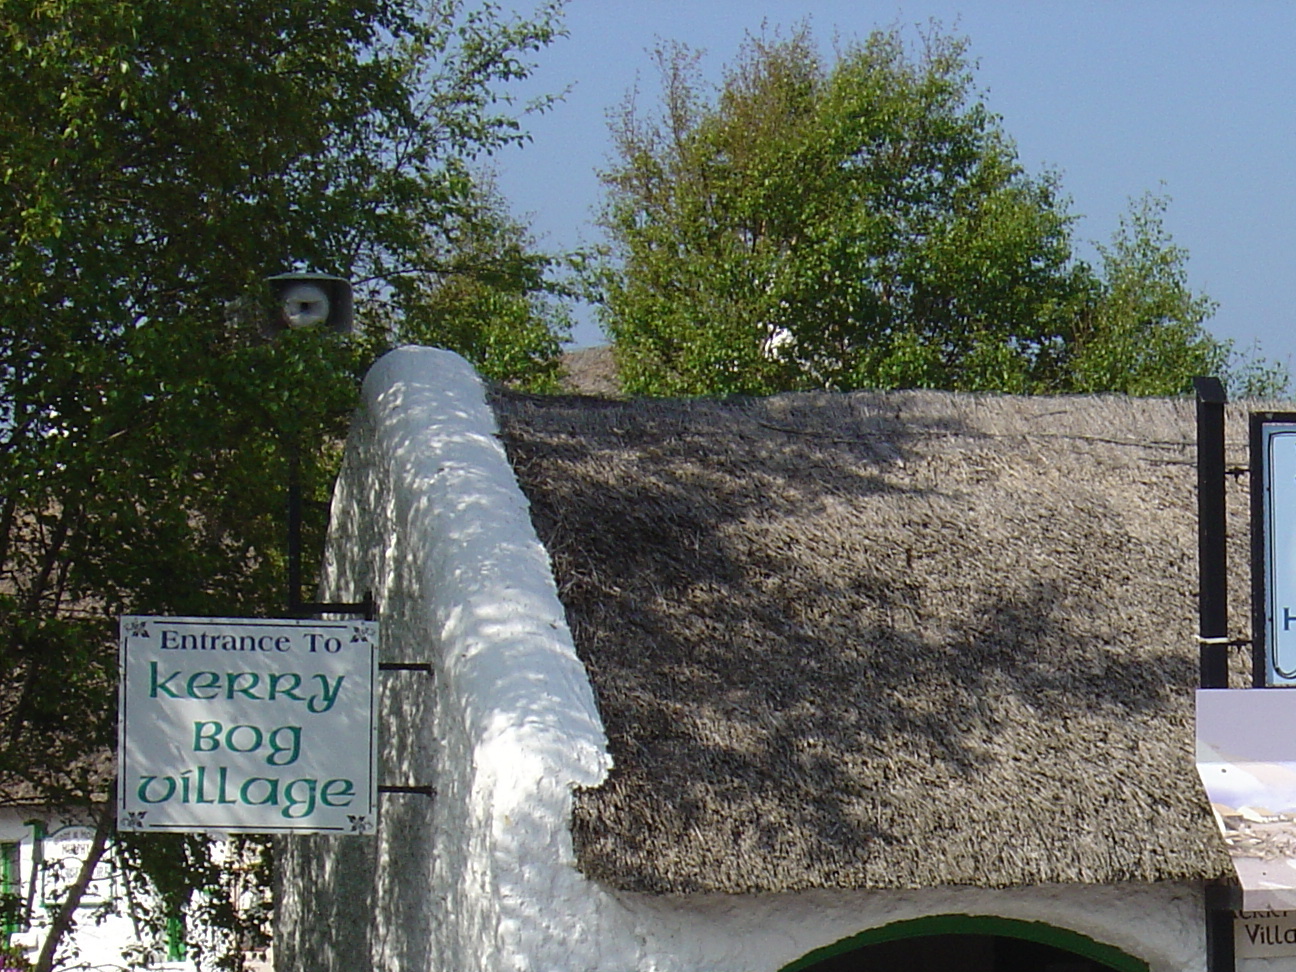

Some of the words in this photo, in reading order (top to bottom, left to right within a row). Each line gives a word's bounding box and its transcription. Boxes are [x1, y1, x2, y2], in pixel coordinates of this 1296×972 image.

[160, 630, 291, 652] Entrance
[303, 633, 342, 653] To
[193, 721, 302, 766] Bog
